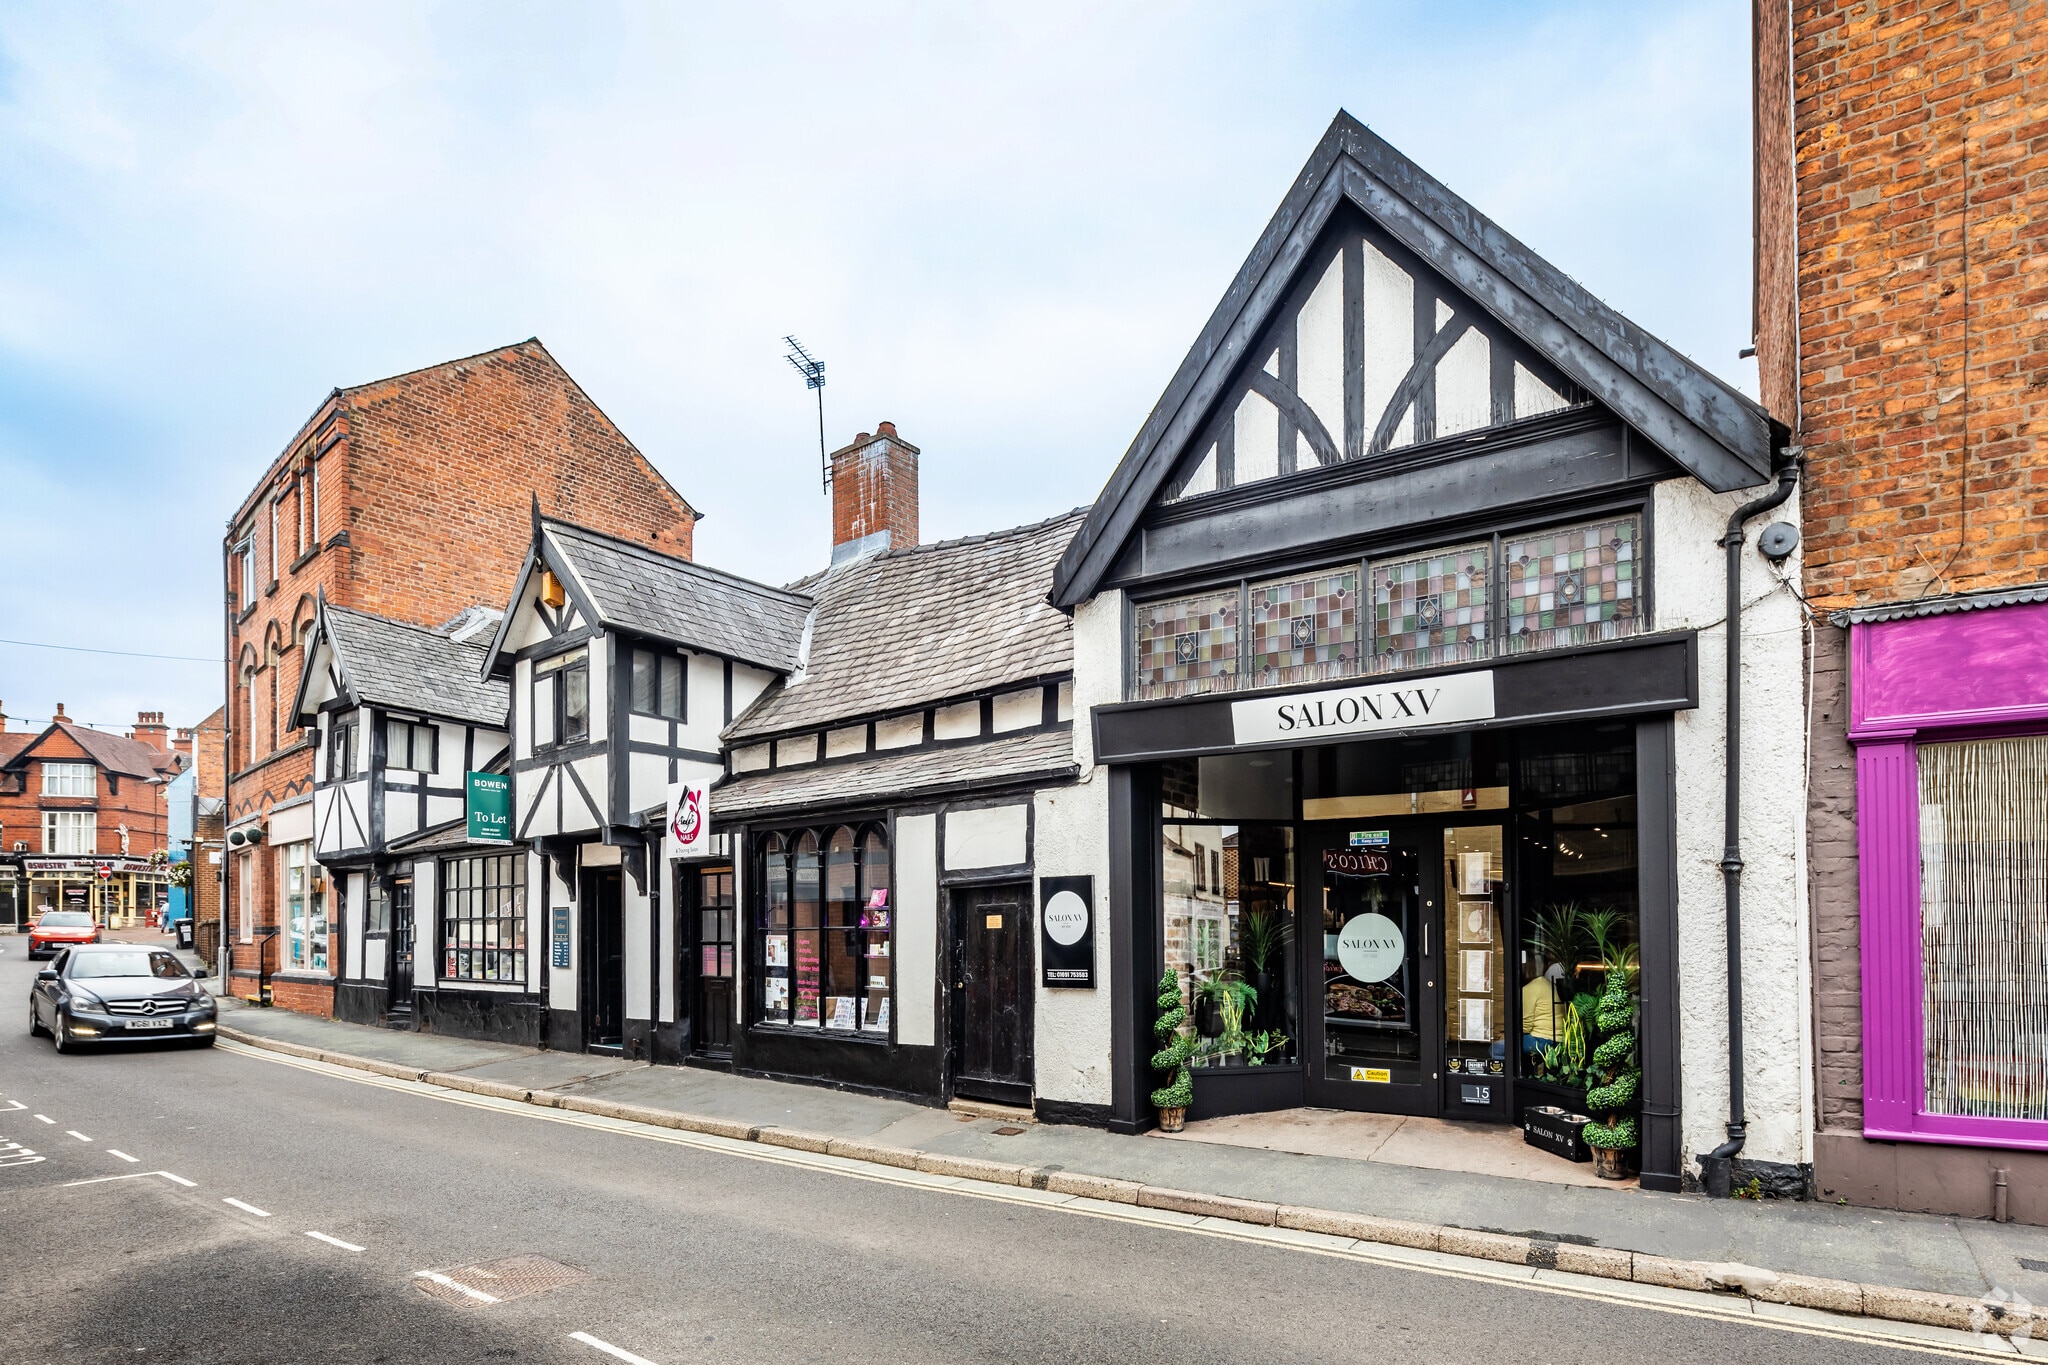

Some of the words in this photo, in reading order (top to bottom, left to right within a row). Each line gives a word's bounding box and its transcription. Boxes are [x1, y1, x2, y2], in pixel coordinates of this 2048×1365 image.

[1278, 693, 1383, 731] SALON
[1390, 688, 1441, 720] XV
[474, 779, 507, 790] BOWEN
[474, 811, 489, 823] To
[491, 812, 507, 825] Let
[680, 833, 694, 841] NAILS
[27, 862, 67, 870] OSWESTRY
[1048, 914, 1072, 922] SALON
[1073, 913, 1083, 922] XV
[1343, 939, 1380, 949] SALON
[1381, 939, 1397, 949] XV
[1475, 1086, 1489, 1099] 15
[1532, 1125, 1554, 1139] SALON
[1555, 1133, 1565, 1143] XV
